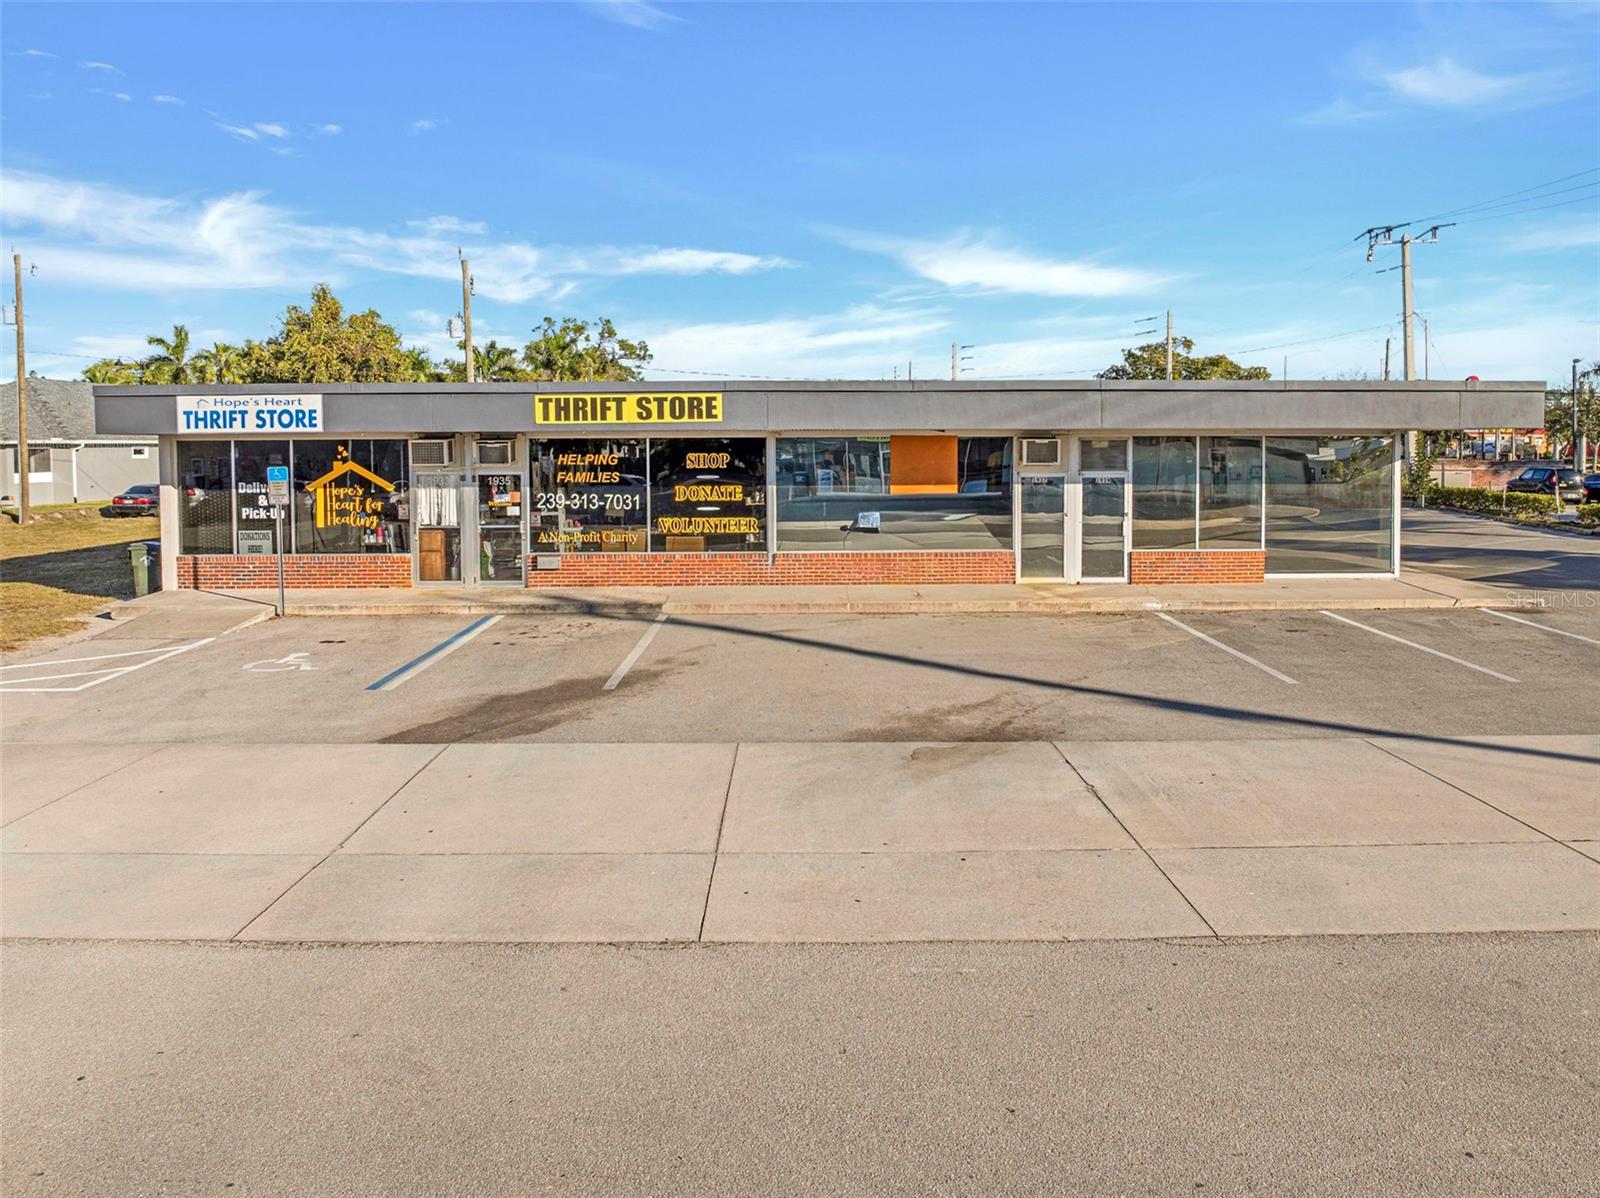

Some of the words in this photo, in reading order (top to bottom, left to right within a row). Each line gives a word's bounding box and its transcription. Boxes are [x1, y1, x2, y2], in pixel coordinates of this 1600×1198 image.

[213, 397, 260, 409] Hope's
[264, 397, 302, 407] Heart
[538, 397, 627, 422] THRIFT
[637, 396, 718, 420] STORE
[183, 410, 249, 430] THRIFT
[256, 409, 318, 429] STORE
[557, 453, 619, 466] HELPING
[686, 453, 730, 469] SHOP
[487, 476, 511, 486] 1935
[556, 471, 620, 484] FAMILIES
[326, 483, 364, 499] Hope's
[674, 485, 743, 502] DONATE
[258, 495, 269, 507] &
[327, 497, 364, 513] Heart
[365, 498, 385, 513] for
[537, 493, 641, 511] 239-313-7031
[327, 511, 379, 530] Healing
[658, 517, 759, 534] VOLUNTEER
[240, 532, 271, 541] DONATIONS
[538, 532, 547, 543] A
[549, 531, 601, 543] Non-Profit
[602, 531, 638, 544] Charity
